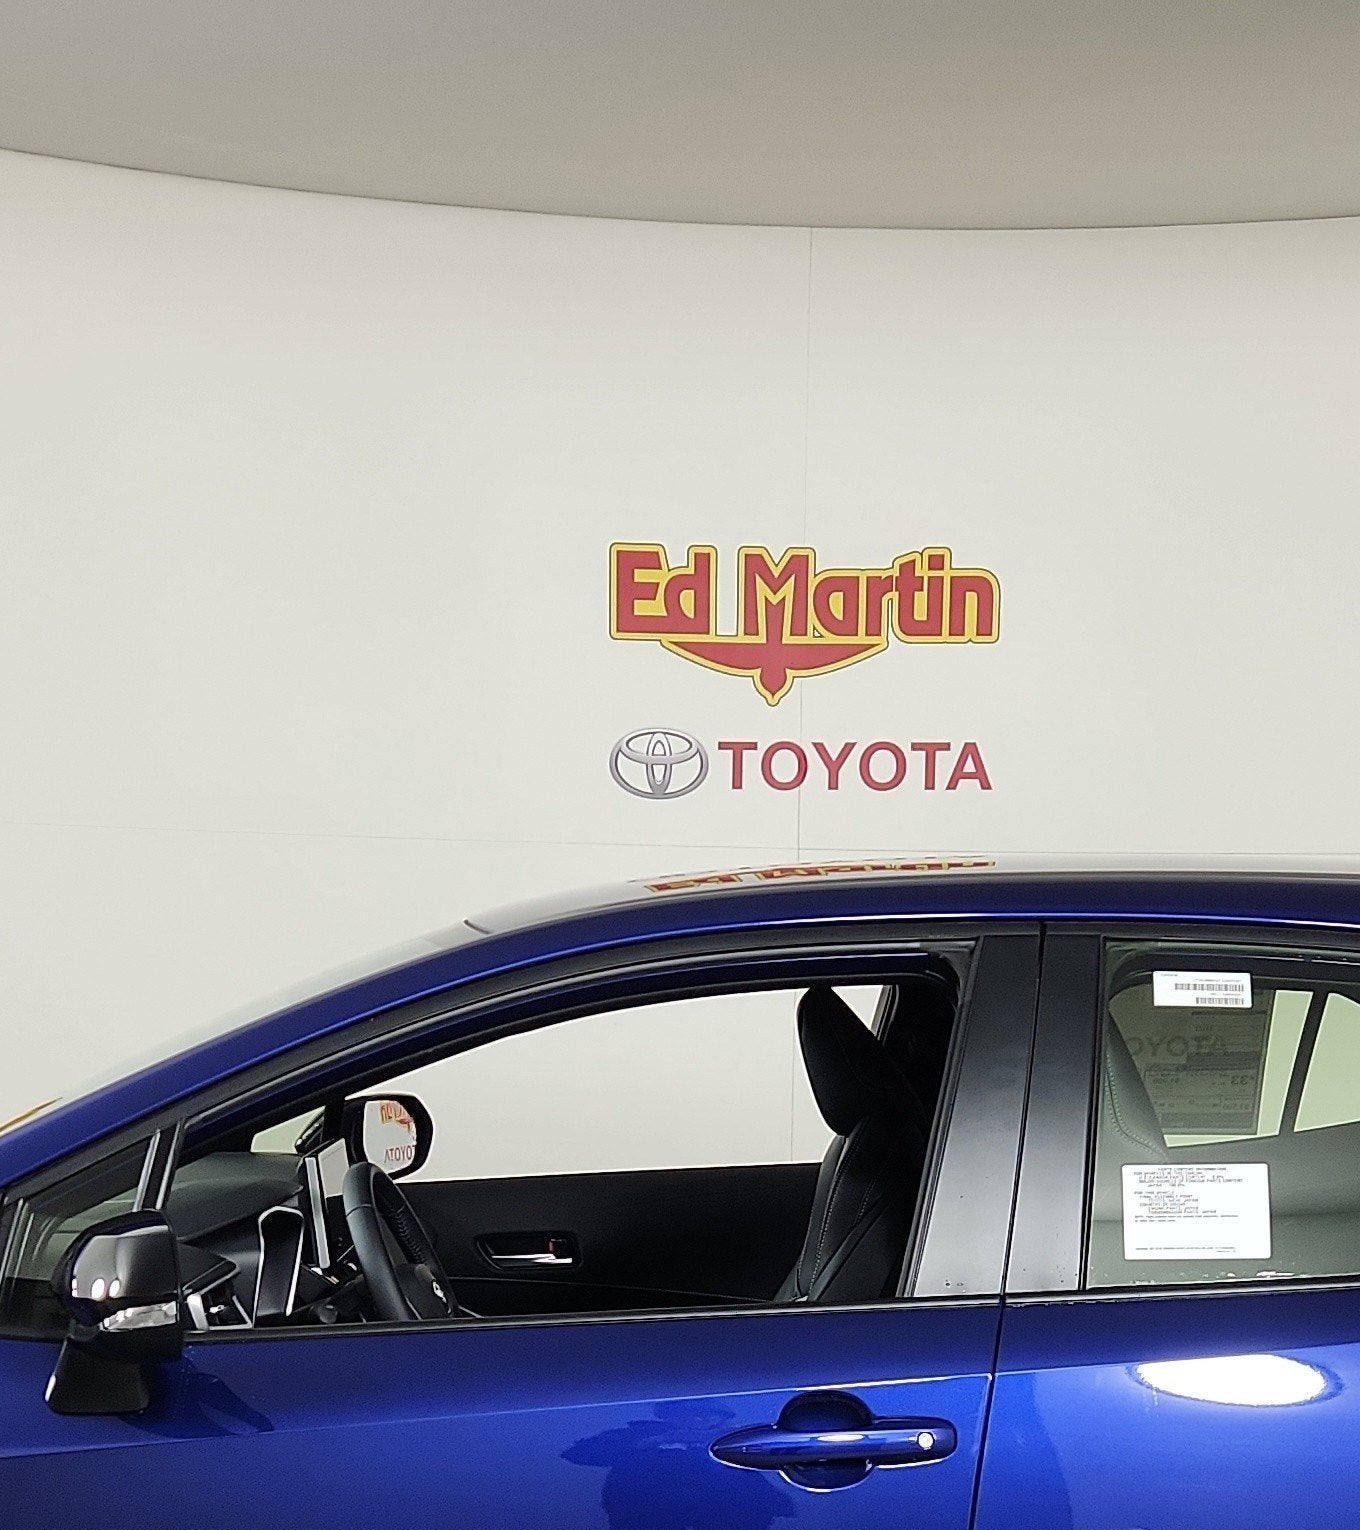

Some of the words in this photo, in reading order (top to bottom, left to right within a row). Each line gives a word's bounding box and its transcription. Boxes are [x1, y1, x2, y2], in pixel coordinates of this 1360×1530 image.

[613, 547, 713, 637] Ed
[741, 550, 997, 640] Martin
[719, 741, 993, 790] TOYOTA
